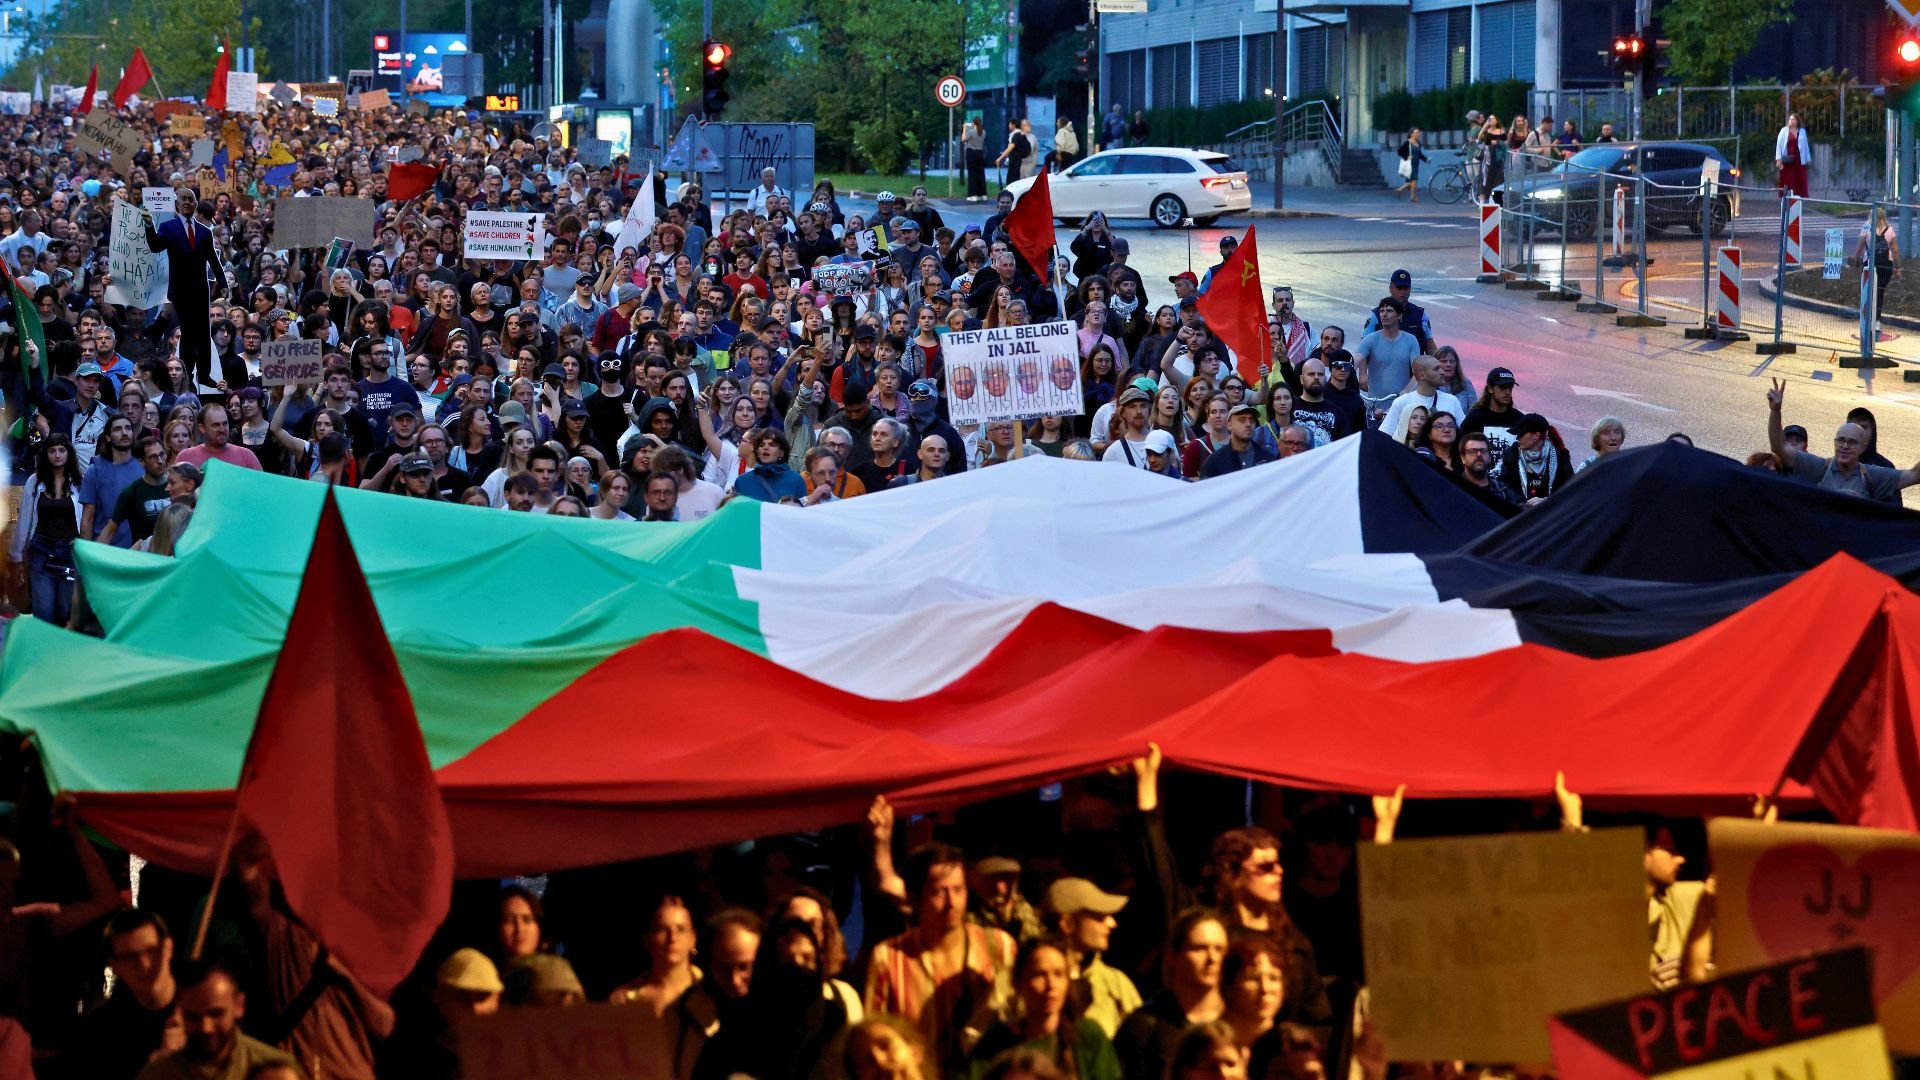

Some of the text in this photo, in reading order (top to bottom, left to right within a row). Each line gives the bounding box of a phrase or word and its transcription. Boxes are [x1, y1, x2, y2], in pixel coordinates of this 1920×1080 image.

[942, 84, 958, 98] 60
[470, 219, 523, 228] #SAVE PALESTINE
[469, 231, 489, 239] #SAVE
[468, 243, 522, 252] #SAVE HUMANITY
[835, 286, 863, 296] GAZI
[948, 324, 1069, 346] THEY ALL BELONG
[268, 342, 320, 357] NO PRIDE
[988, 341, 1040, 357] IN JAIL
[1628, 960, 1824, 1072] PEACE
